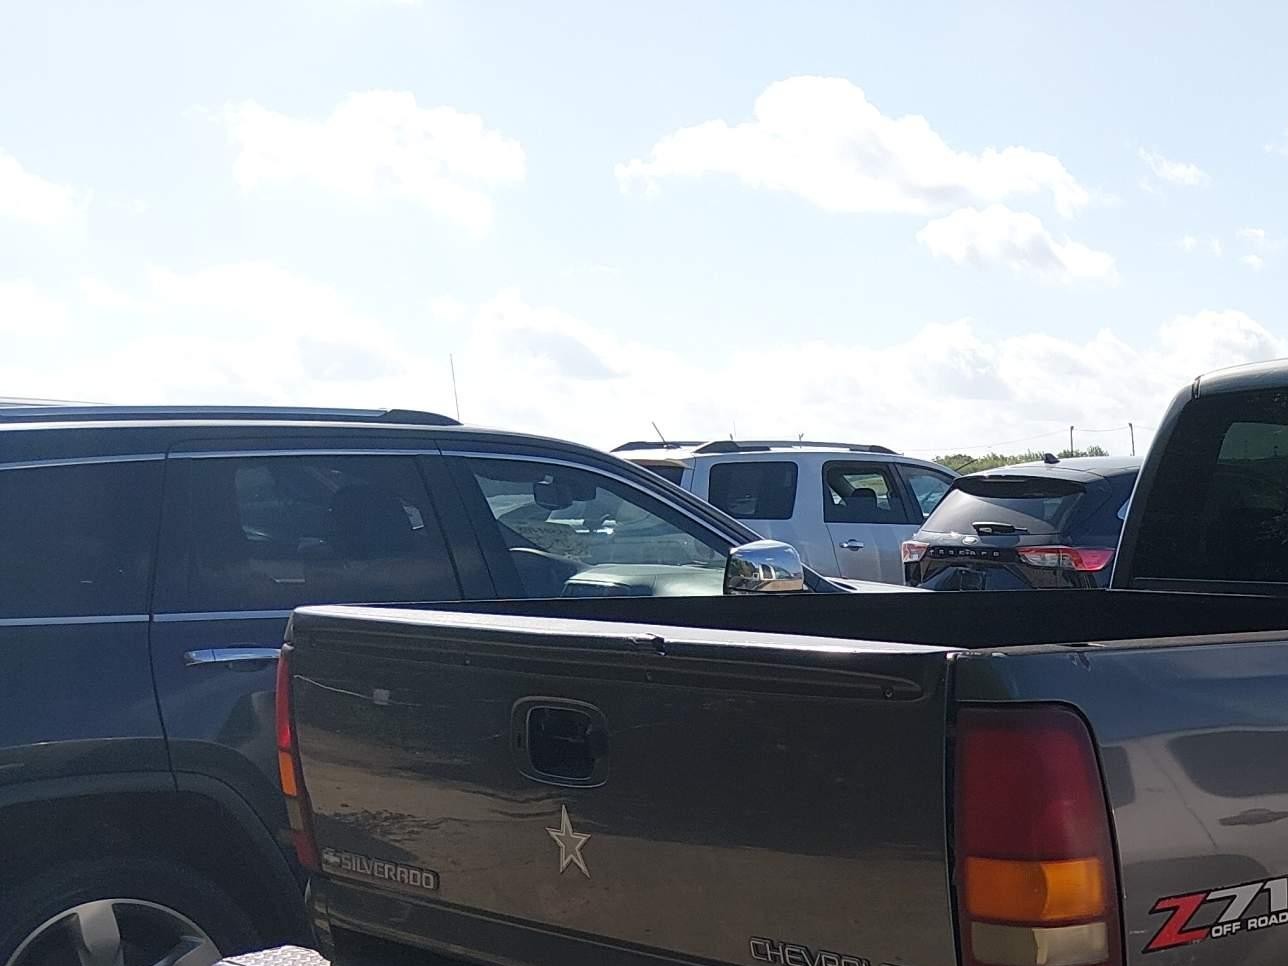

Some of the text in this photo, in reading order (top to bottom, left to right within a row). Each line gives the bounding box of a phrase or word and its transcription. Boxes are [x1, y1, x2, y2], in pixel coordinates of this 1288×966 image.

[341, 853, 435, 889] SILVERADO
[1142, 875, 1288, 953] Z71
[1210, 921, 1242, 939] OFF
